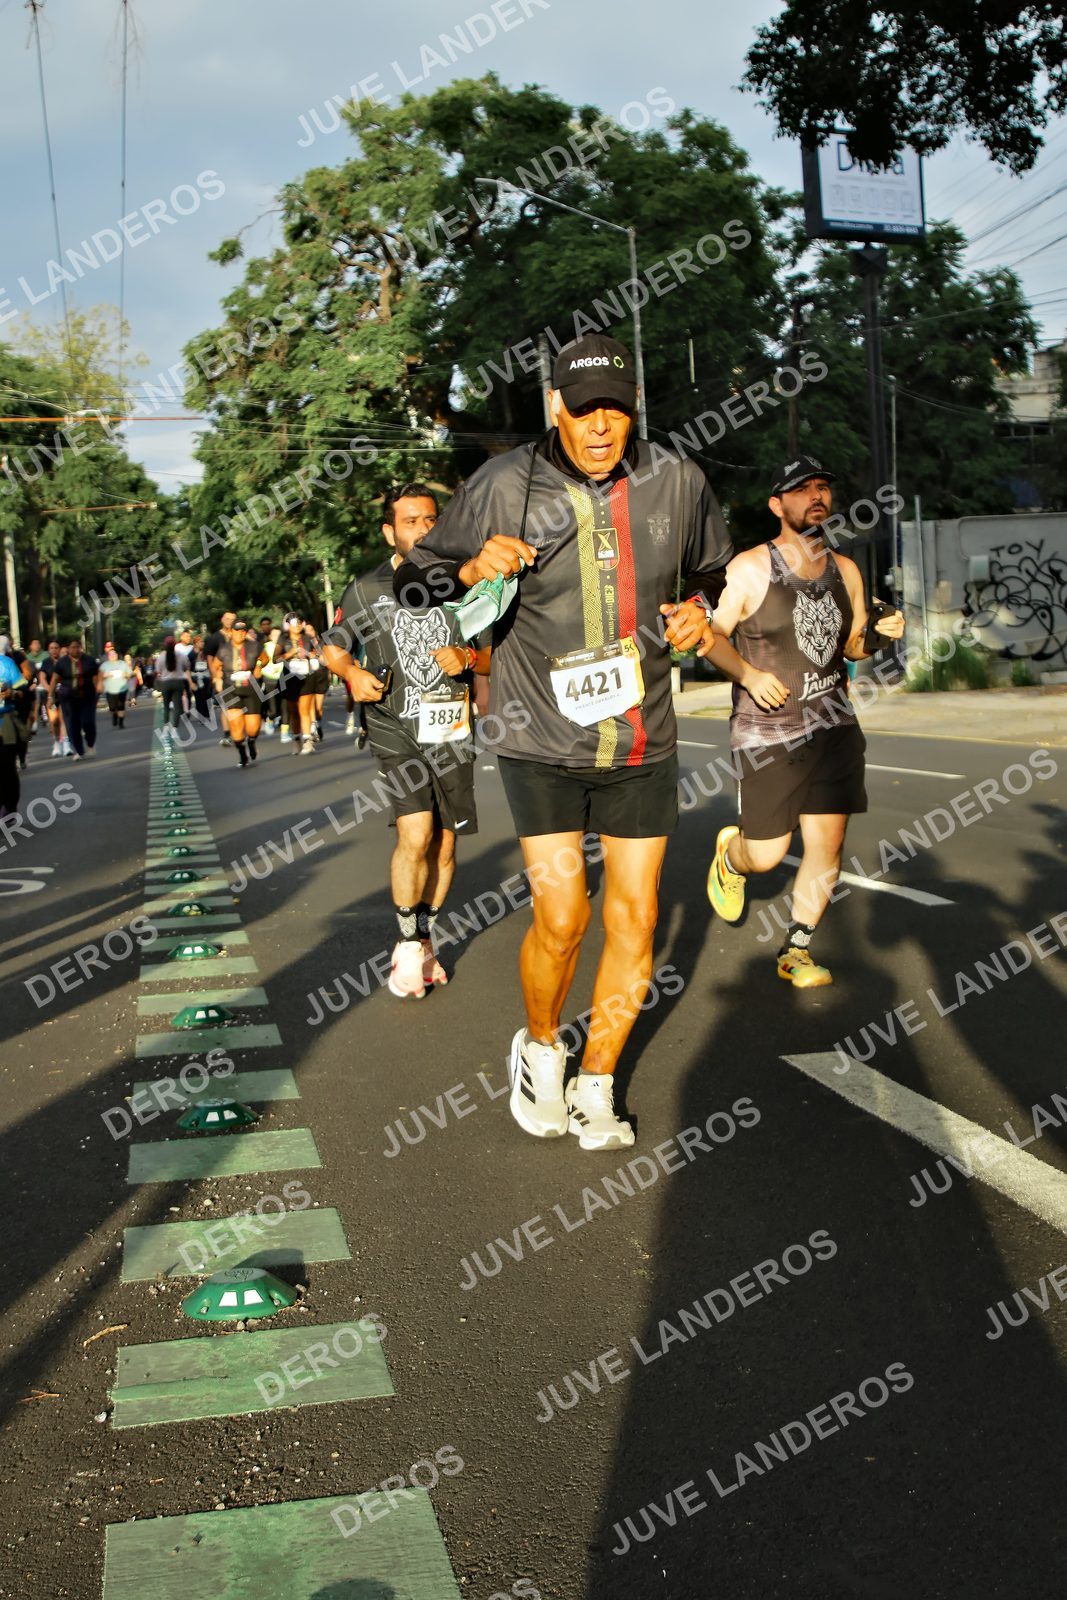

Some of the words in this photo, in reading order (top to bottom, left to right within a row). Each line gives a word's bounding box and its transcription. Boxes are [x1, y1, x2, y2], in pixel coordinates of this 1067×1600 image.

[569, 356, 610, 370] ARGOS
[989, 539, 1044, 560] TOY
[565, 667, 622, 702] 4421
[803, 672, 819, 682] LA
[428, 708, 462, 726] 3834
